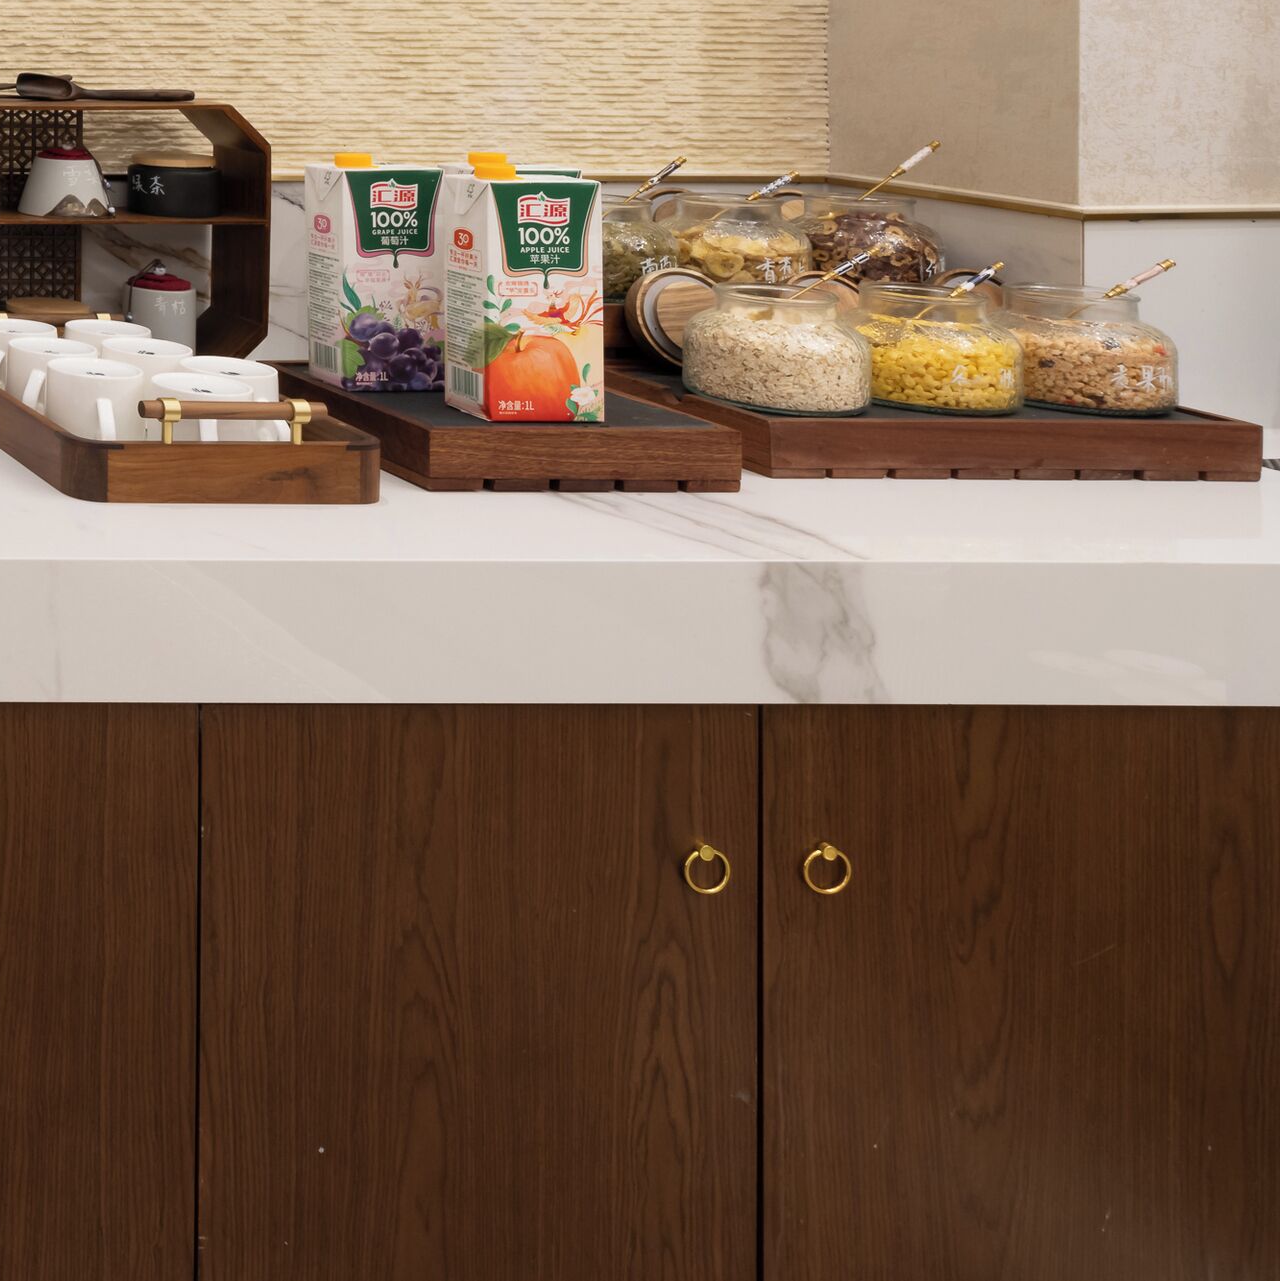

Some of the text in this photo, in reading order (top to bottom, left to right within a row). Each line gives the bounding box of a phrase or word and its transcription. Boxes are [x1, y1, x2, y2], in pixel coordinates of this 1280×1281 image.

[372, 190, 416, 203] 汇源
[520, 204, 568, 218] 汇源
[370, 211, 418, 228] 100%
[381, 236, 408, 246] 葡萄汁
[518, 227, 570, 245] 100%
[530, 254, 560, 265] 苹果汁
